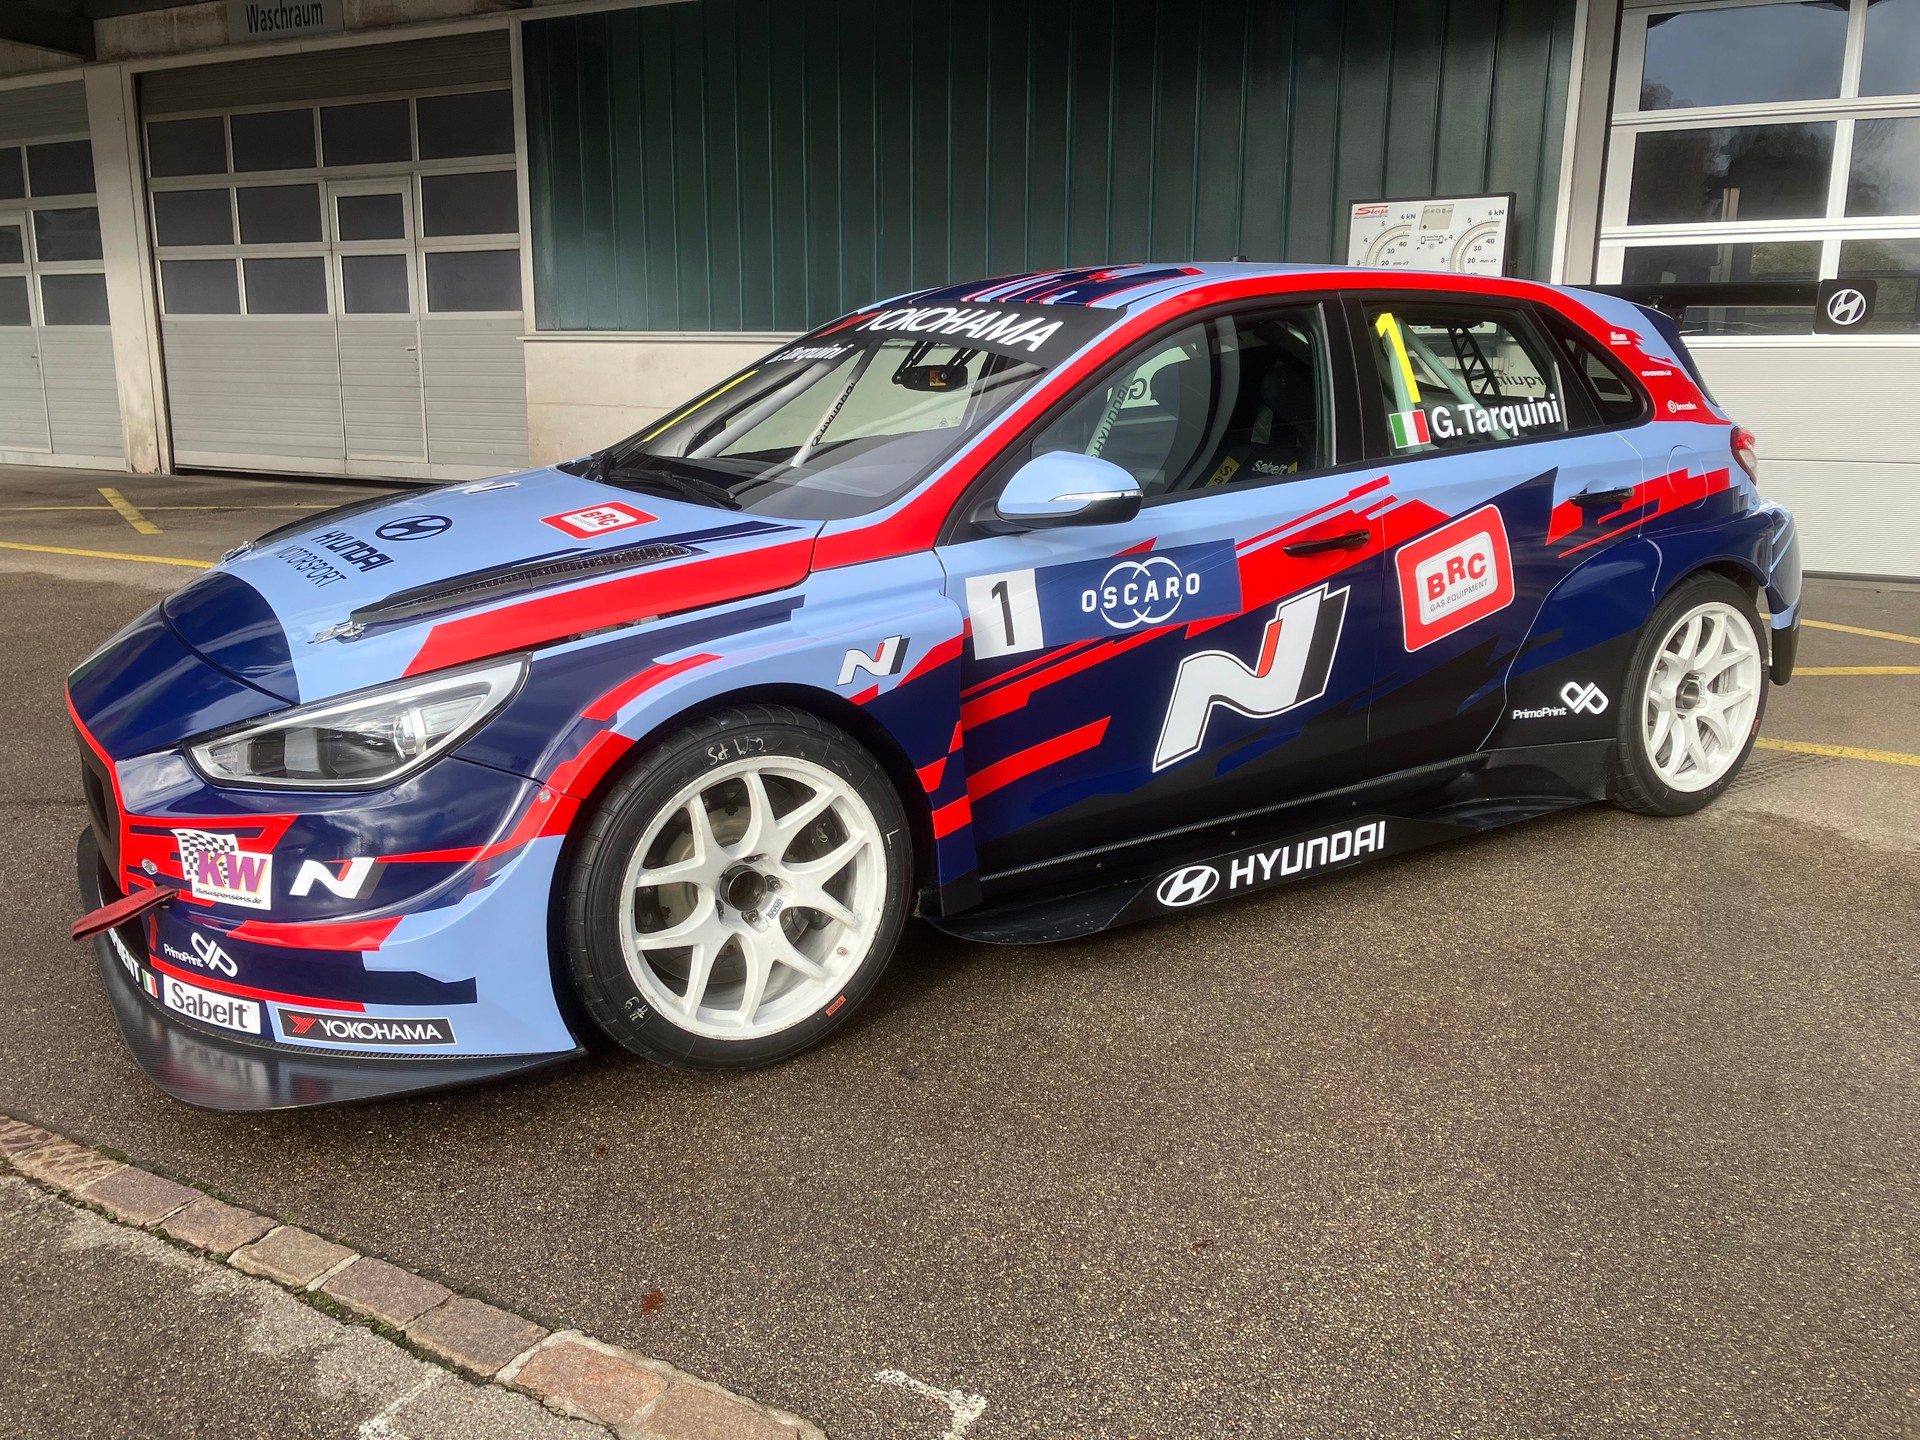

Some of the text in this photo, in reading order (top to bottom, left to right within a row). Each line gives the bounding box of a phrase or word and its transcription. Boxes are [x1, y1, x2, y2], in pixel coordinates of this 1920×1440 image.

[245, 0, 324, 33] Waschraum
[855, 307, 1064, 352] YOKOHAMA
[1375, 313, 1421, 404] 1
[1093, 384, 1130, 453] HYUNDAI
[1431, 393, 1562, 438] G.Tarquini
[1251, 459, 1288, 476] Sabelt
[580, 510, 620, 526] BRC
[273, 544, 348, 588] MOTORSPORT
[310, 530, 395, 574] HYUNDAI
[1080, 572, 1201, 614] OSCARO
[1426, 552, 1488, 602] BRC
[1429, 578, 1489, 613] GAS EQUIPMENT
[990, 580, 1016, 647] 1
[1512, 706, 1568, 721] PrimoPrint
[197, 849, 269, 895] KW
[1229, 820, 1387, 890] HYUNDAI
[163, 943, 204, 969] PrimoPrint
[171, 980, 250, 1031] Sabelt
[318, 1018, 444, 1041] YOKOHAMA
